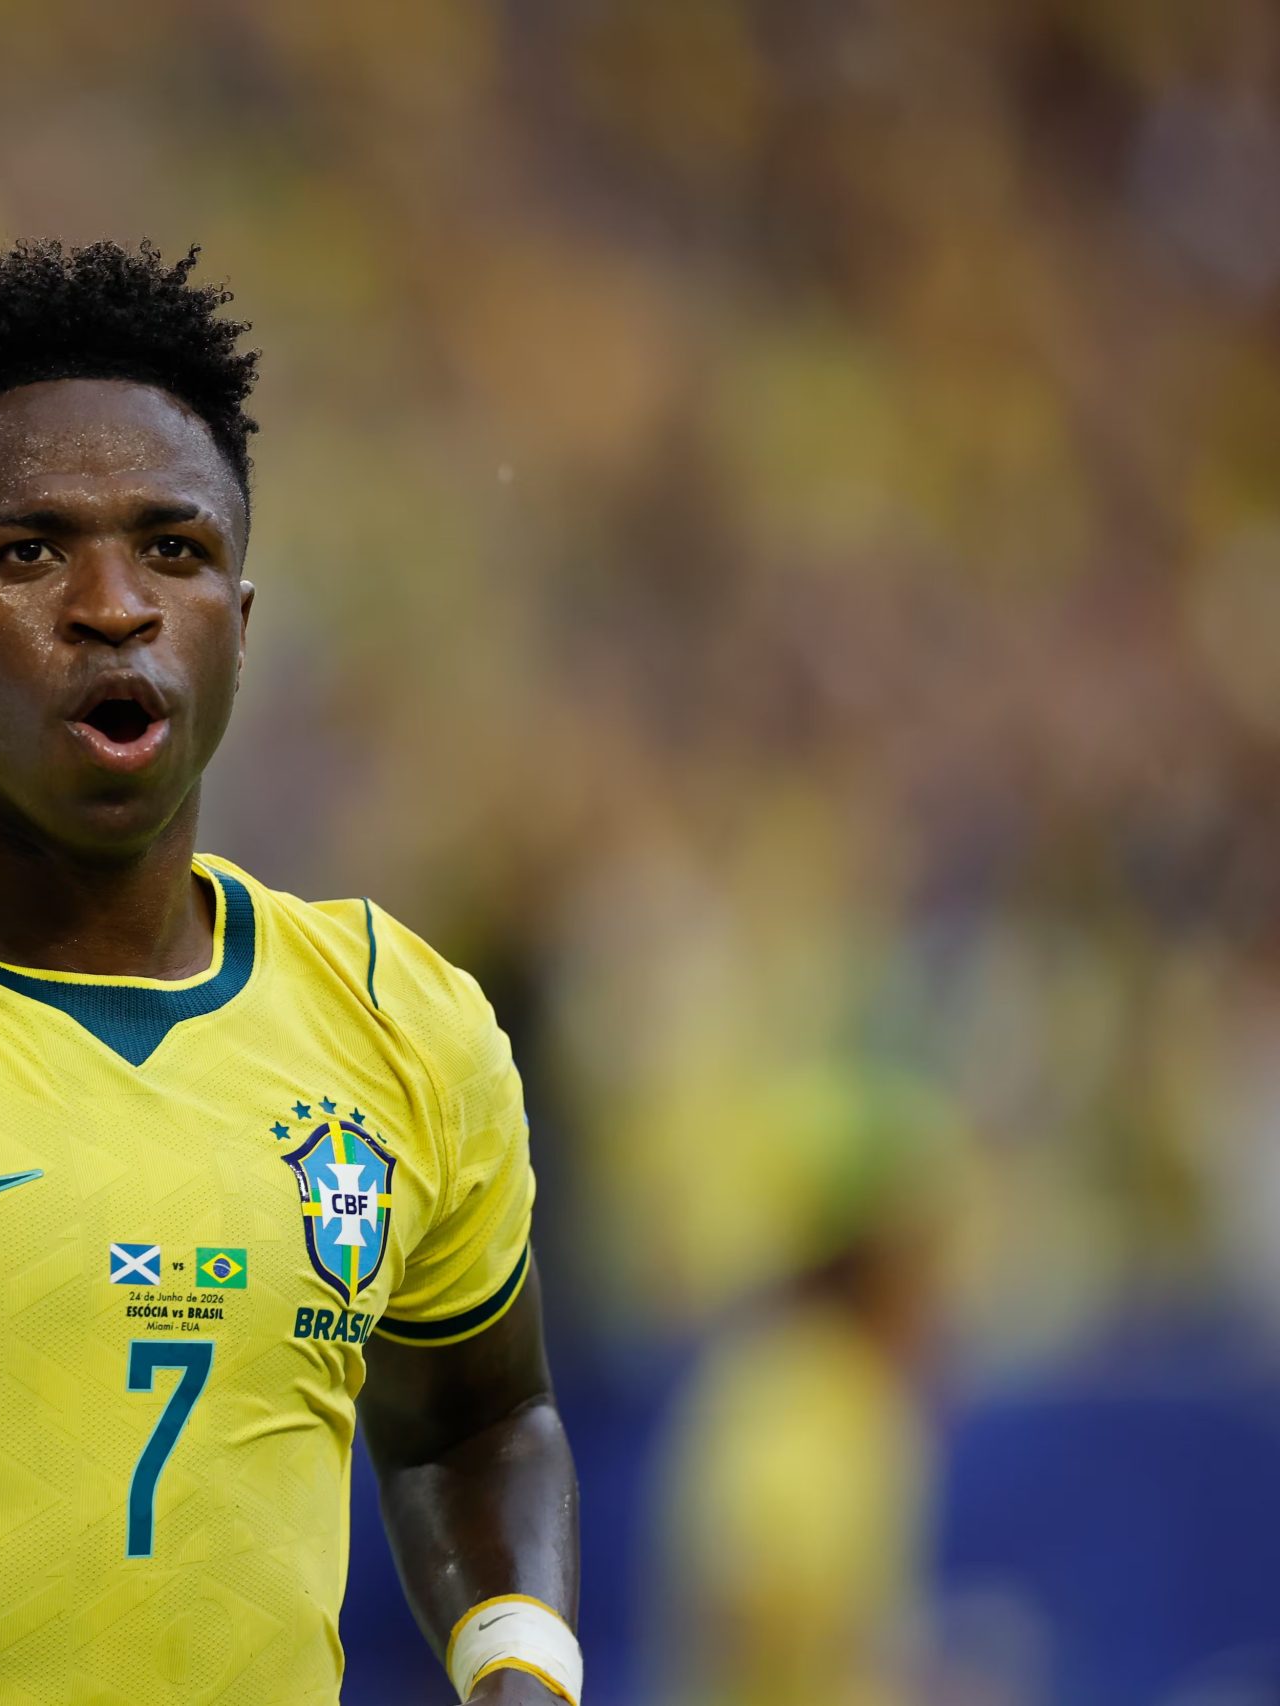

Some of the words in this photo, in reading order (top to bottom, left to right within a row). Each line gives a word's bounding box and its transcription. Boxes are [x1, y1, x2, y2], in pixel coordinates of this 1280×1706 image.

[331, 1193, 368, 1215] CBF
[172, 1261, 185, 1271] vs
[129, 1291, 141, 1301] 24
[143, 1291, 155, 1301] de
[157, 1292, 183, 1302] Junho
[186, 1293, 197, 1303] de
[201, 1294, 224, 1304] 2026
[126, 1304, 168, 1318] ESCÓCIA
[172, 1309, 184, 1318] vs
[187, 1307, 224, 1320] BRASIL
[146, 1322, 174, 1331] Miami
[181, 1322, 200, 1331] EUA
[126, 1339, 215, 1560] 7
